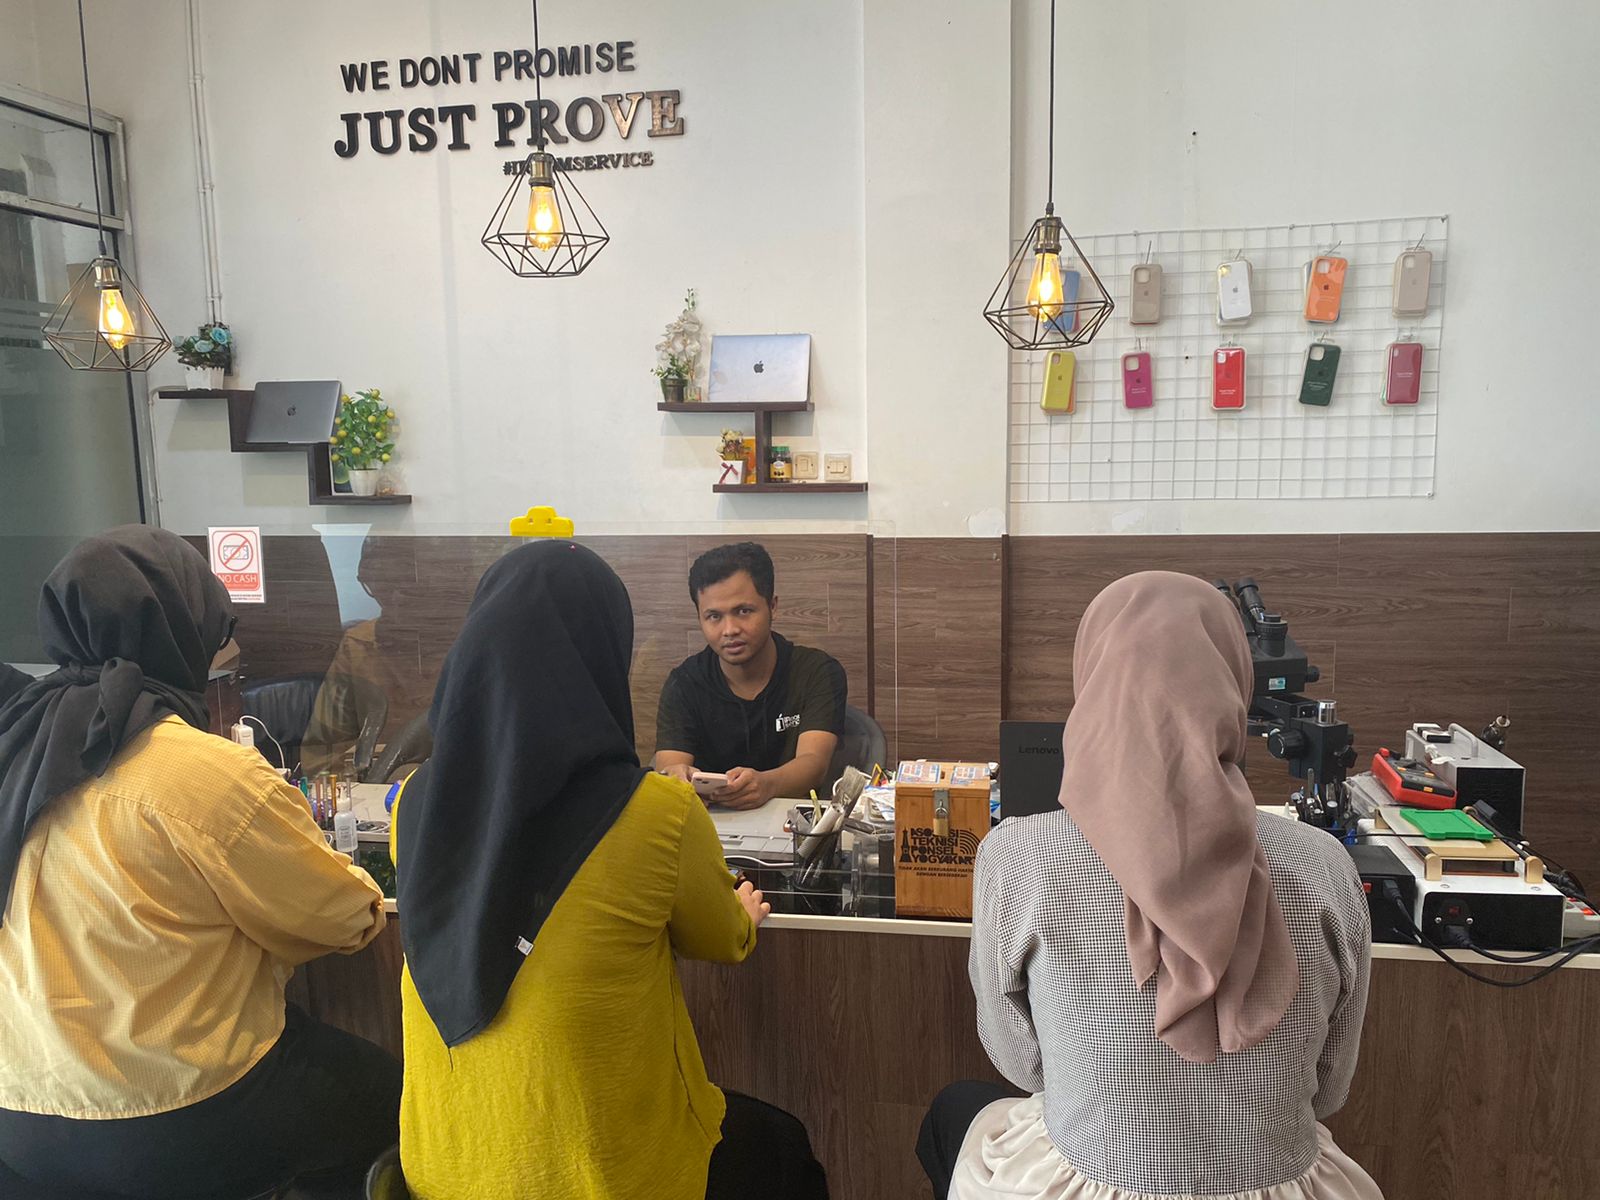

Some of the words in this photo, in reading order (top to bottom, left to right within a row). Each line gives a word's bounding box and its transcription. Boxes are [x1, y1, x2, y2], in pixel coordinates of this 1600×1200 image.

[340, 61, 390, 93] WE
[399, 53, 481, 88] DONT
[493, 41, 635, 81] PROMISE
[334, 104, 476, 159] JUST
[492, 90, 685, 147] PROVE
[233, 574, 257, 583] CASH
[1018, 745, 1060, 755] Lenovo
[911, 828, 959, 838] ASOSI
[911, 837, 959, 847] TEKNISI
[911, 846, 958, 855] PONSEL
